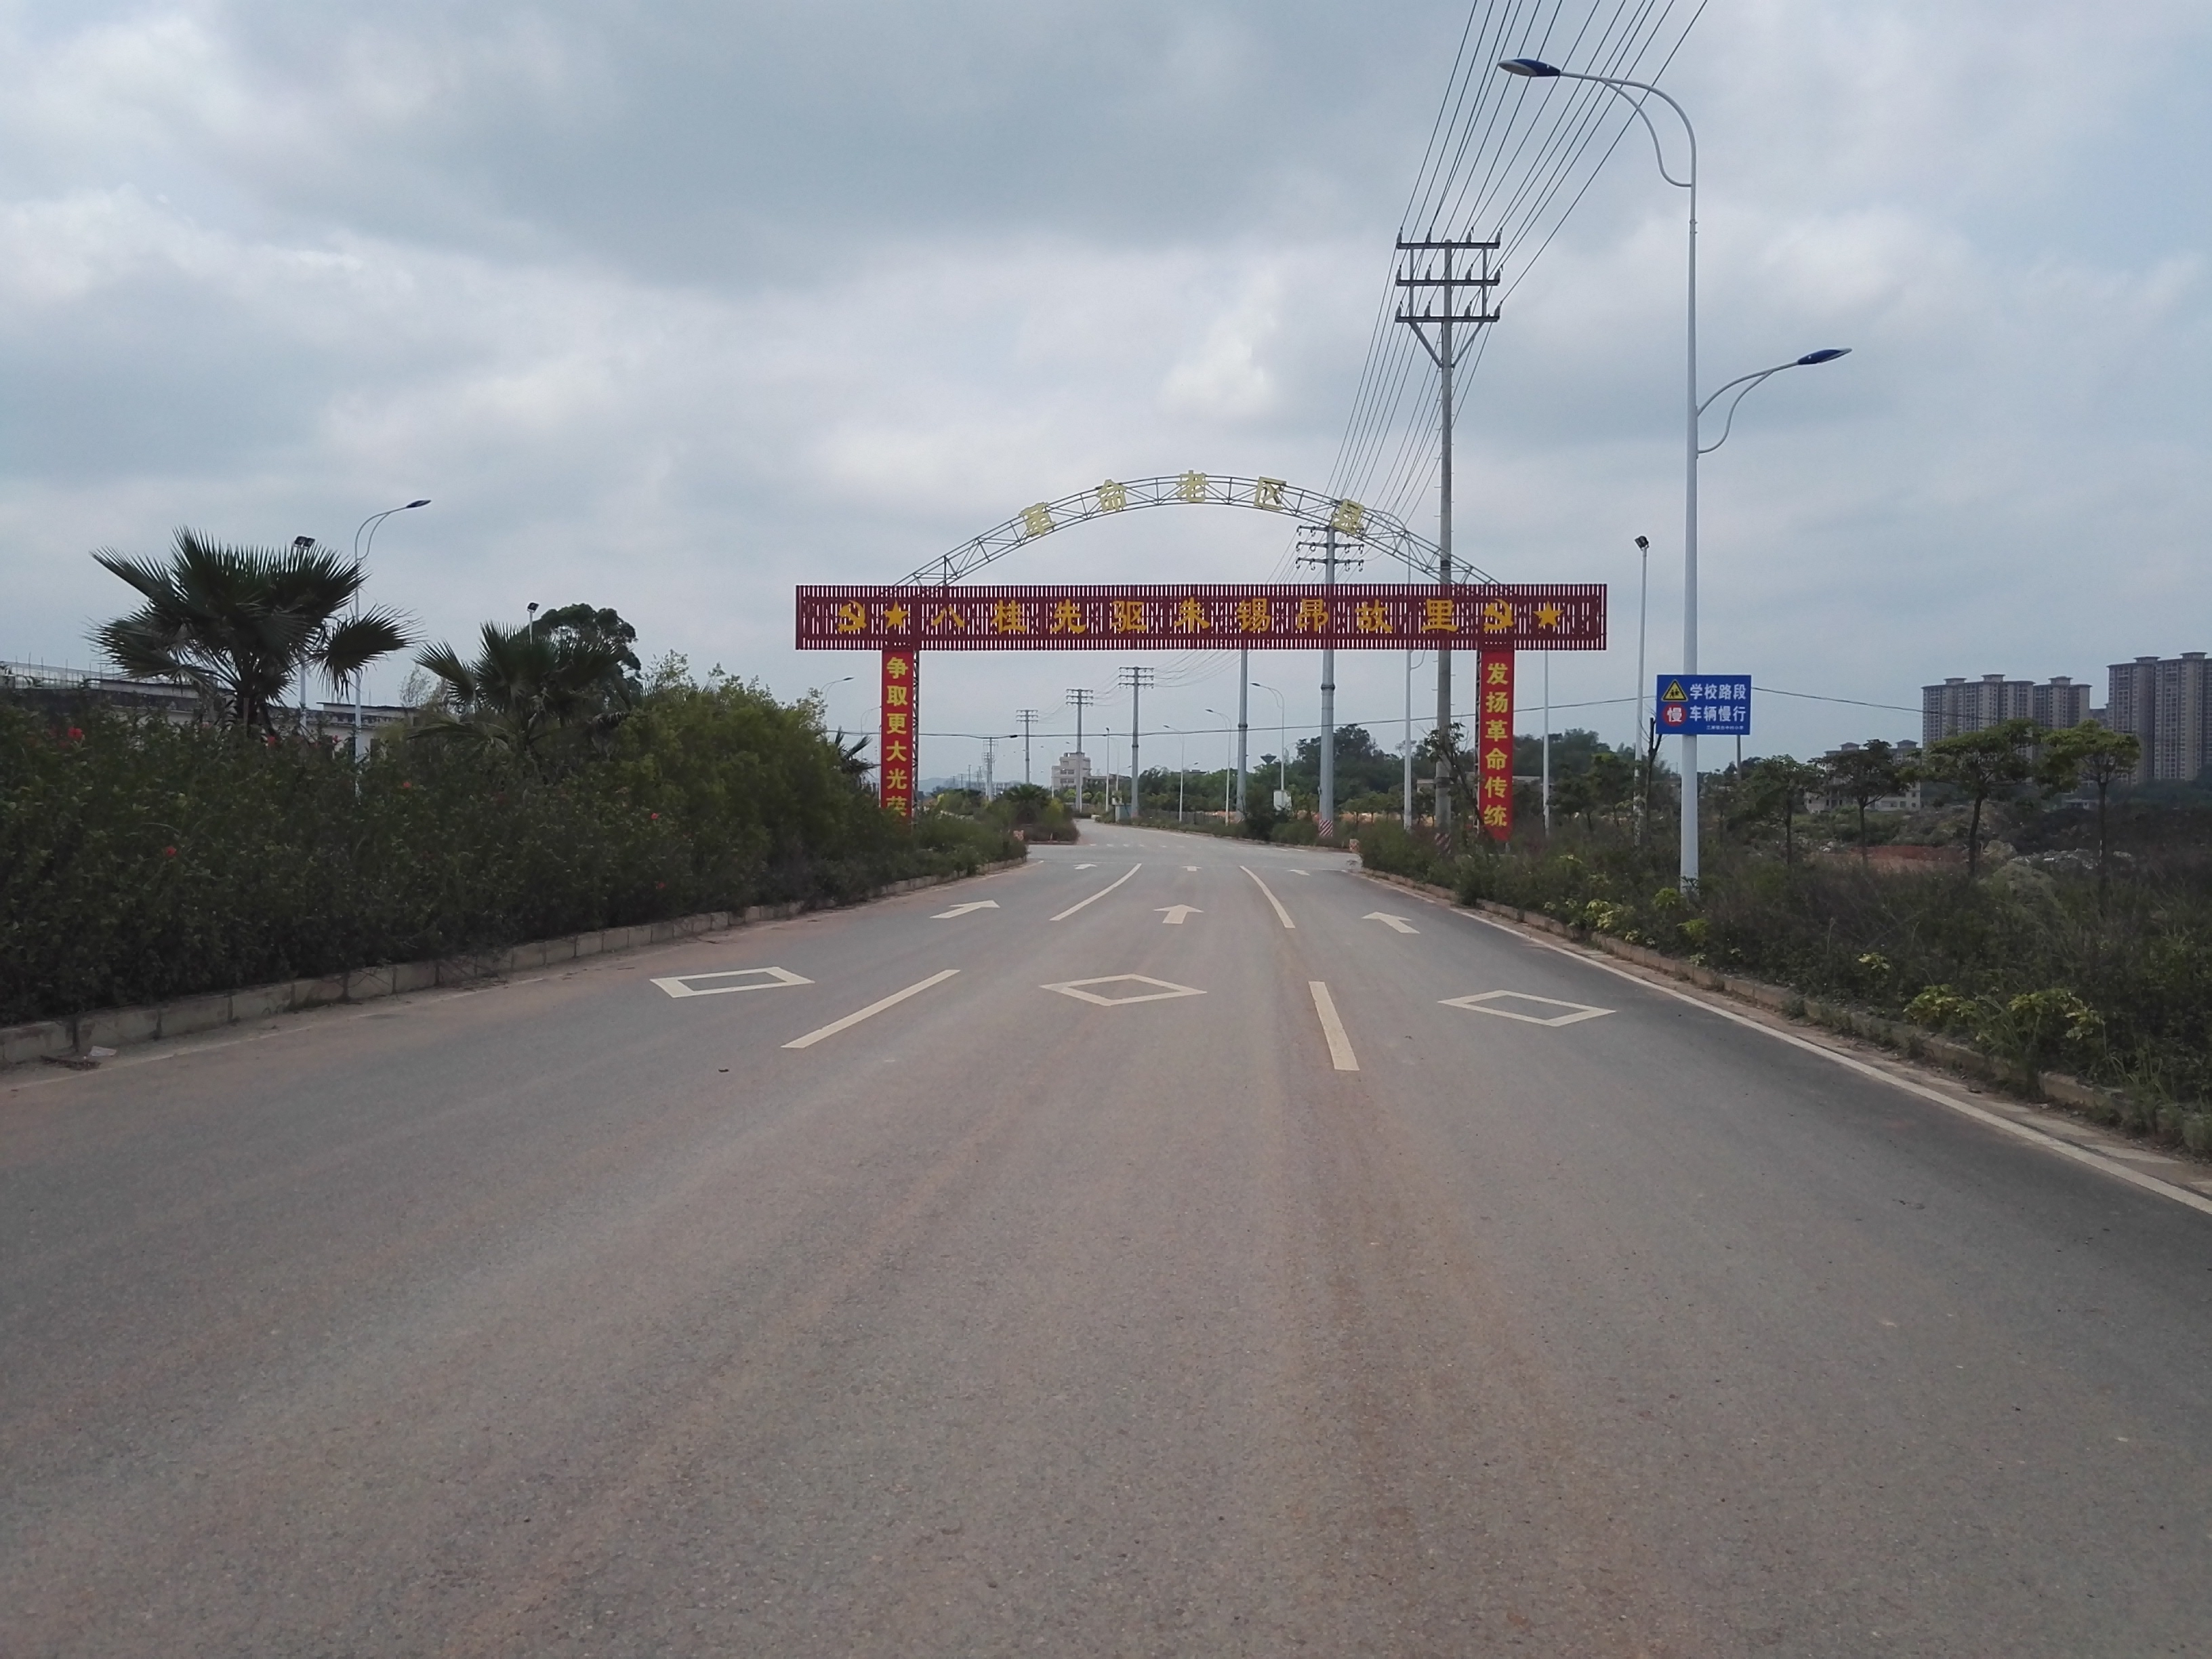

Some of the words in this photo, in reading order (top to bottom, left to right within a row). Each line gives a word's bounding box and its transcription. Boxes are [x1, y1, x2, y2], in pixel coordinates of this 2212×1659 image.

[1019, 470, 1365, 537] 革命老区县
[933, 598, 1458, 634] 八桂先驱朱锡昂故里
[1689, 683, 1747, 700] 学校路段
[1666, 707, 1683, 722] 慢
[1689, 705, 1746, 722] 车辆慢行
[1483, 662, 1509, 827] 发扬革命传统
